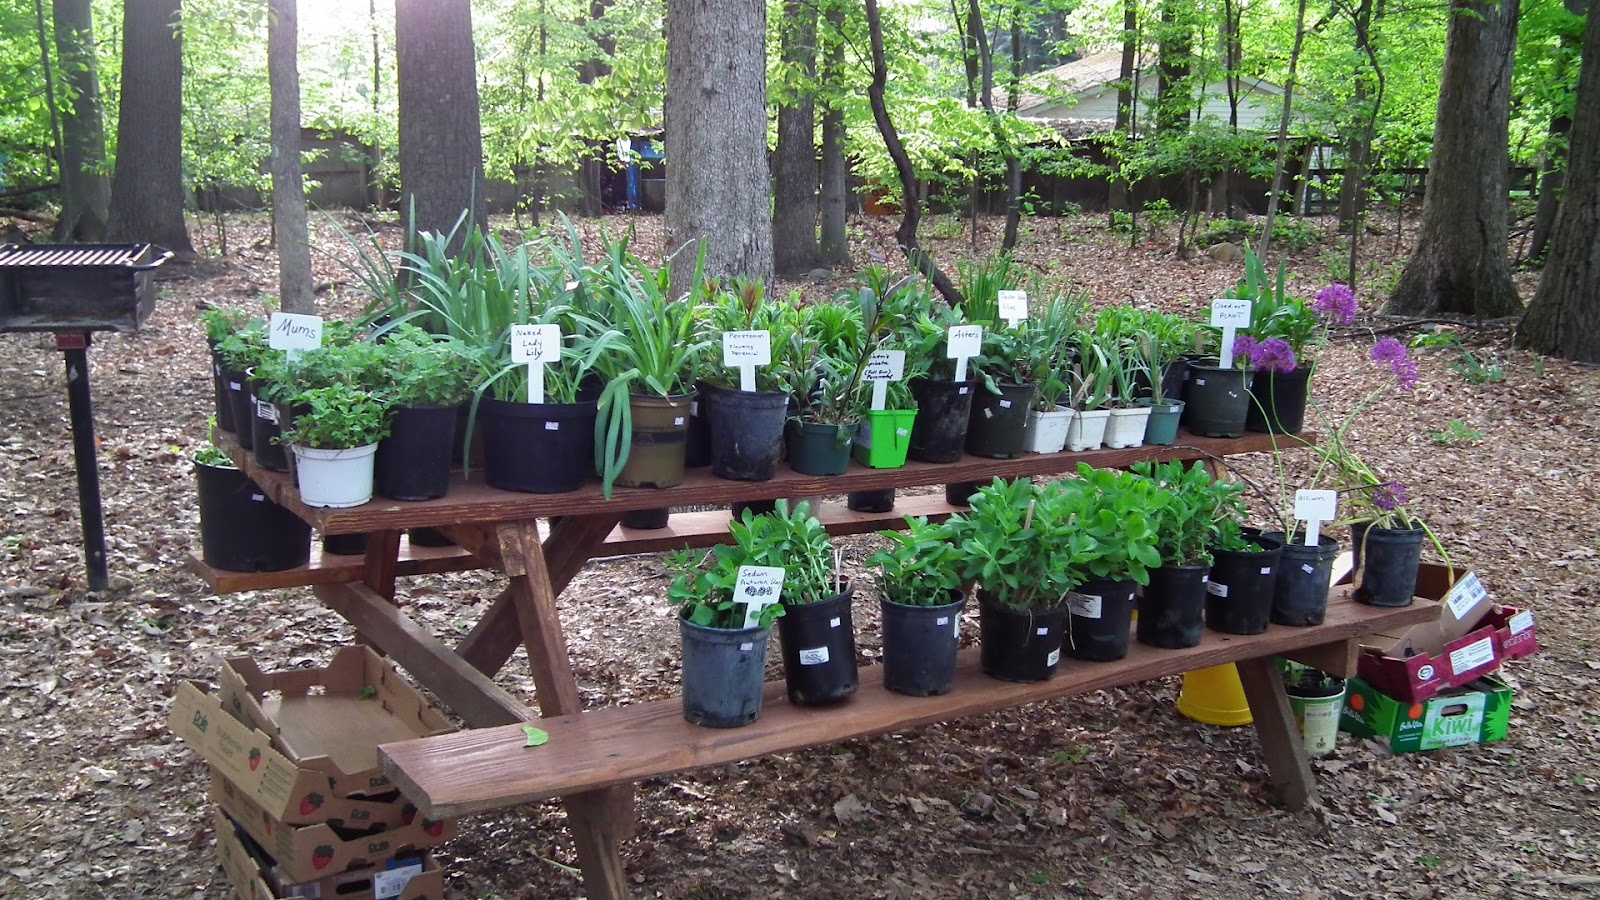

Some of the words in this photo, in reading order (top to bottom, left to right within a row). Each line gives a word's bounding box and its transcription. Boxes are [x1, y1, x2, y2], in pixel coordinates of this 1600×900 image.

[276, 318, 316, 339] Mums
[516, 328, 543, 336] Naked
[953, 330, 979, 339] Asters
[522, 339, 542, 350] Lady
[526, 348, 544, 360] Lily
[742, 568, 768, 578] Sedum
[1431, 714, 1474, 738] Kiwi
